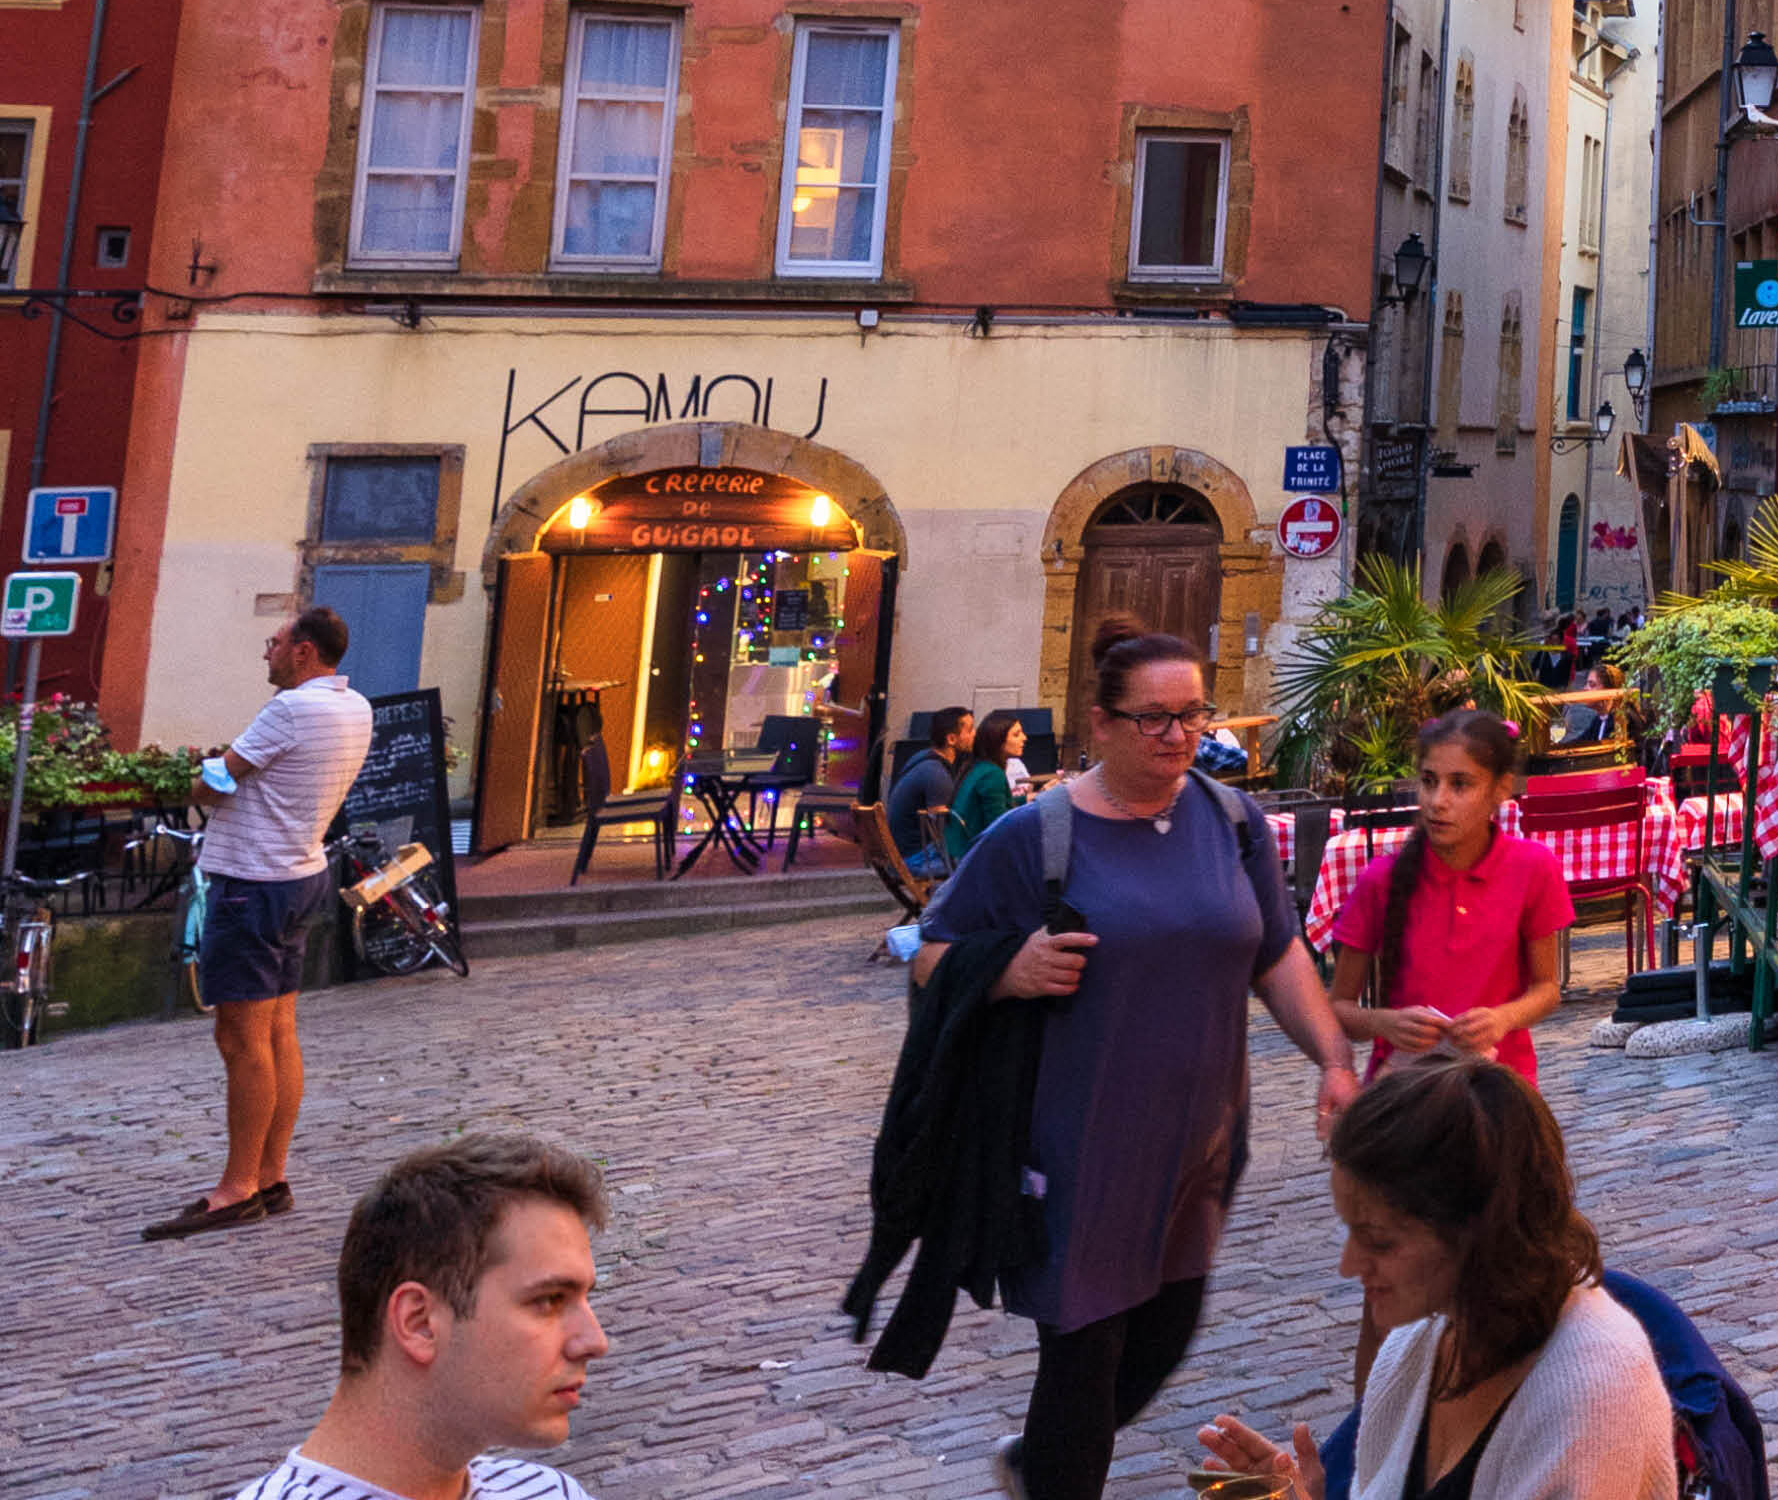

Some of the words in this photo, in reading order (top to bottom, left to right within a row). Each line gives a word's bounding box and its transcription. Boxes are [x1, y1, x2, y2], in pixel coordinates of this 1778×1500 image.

[1297, 451, 1327, 461] PLACE
[1297, 463, 1309, 473] DE
[1313, 463, 1325, 473] LA
[1290, 475, 1331, 487] TRINITÉ
[26, 586, 54, 612] P
